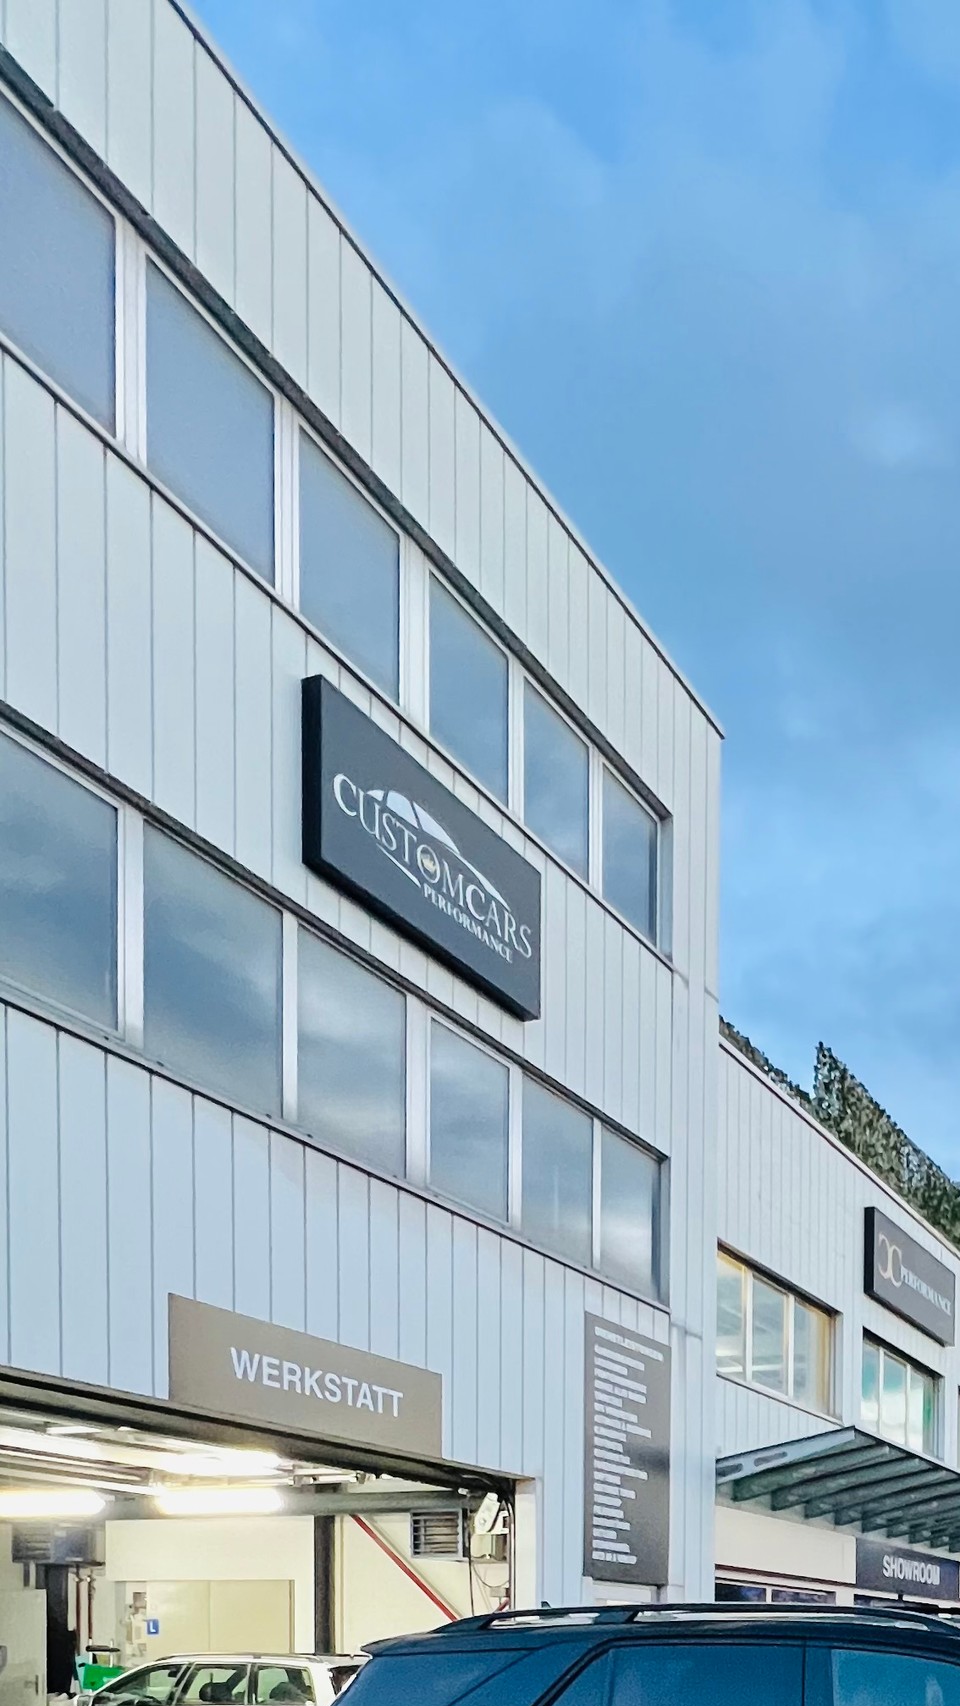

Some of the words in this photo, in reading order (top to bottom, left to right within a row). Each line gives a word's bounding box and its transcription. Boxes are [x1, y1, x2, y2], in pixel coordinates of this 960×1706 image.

[333, 773, 532, 958] CUSTOMCARS
[423, 883, 513, 963] PERFORMANCE
[230, 1347, 404, 1417] WERKSTATT
[882, 1555, 940, 1585] SHOWROOM
